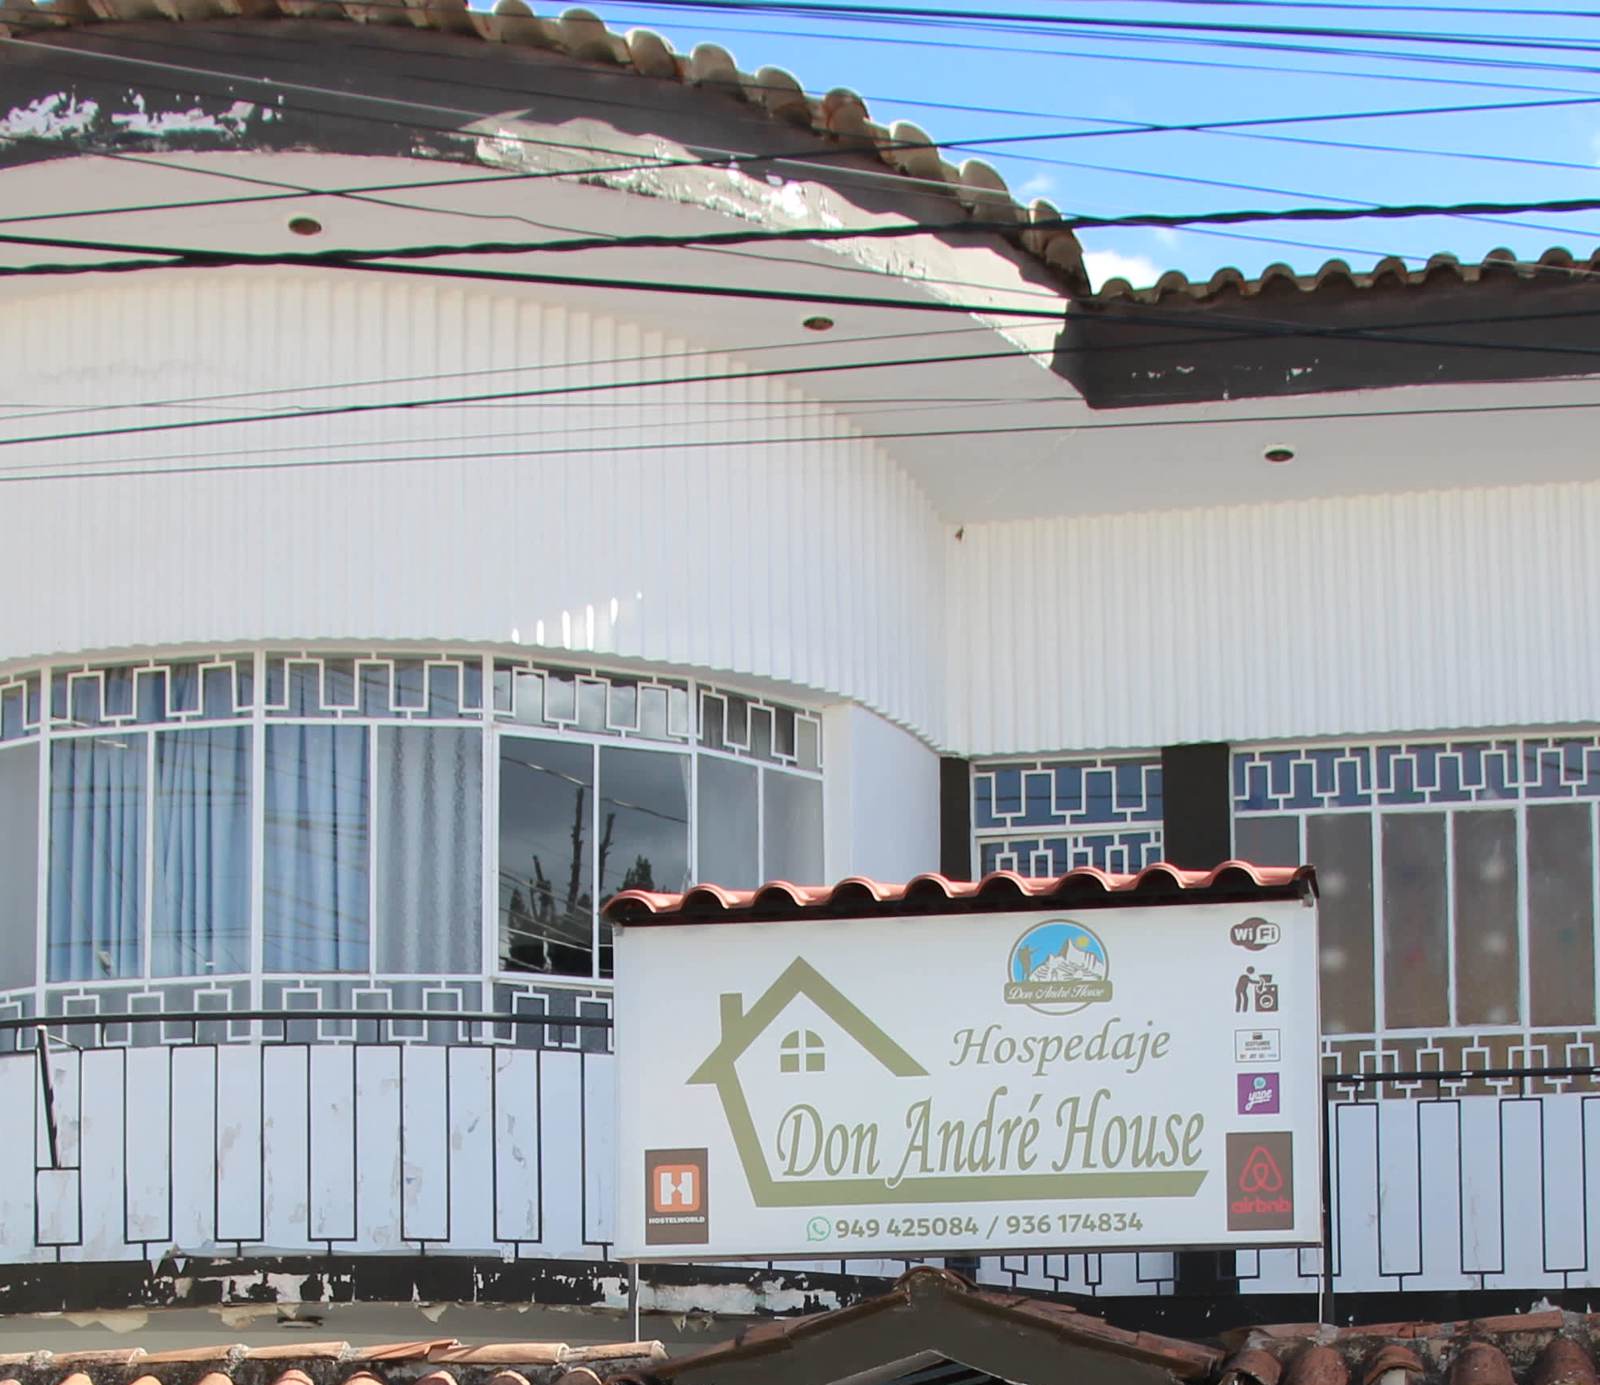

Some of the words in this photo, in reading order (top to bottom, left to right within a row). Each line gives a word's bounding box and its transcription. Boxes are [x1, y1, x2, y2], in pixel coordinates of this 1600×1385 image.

[1007, 985, 1033, 1000] Don
[948, 1016, 1171, 1077] Hospedaje
[776, 1102, 880, 1177] Don
[886, 1085, 1043, 1187] André
[1051, 1087, 1205, 1172] House
[1231, 1195, 1292, 1214] airbnb
[648, 1216, 706, 1225] HOSTELWORLD
[835, 1218, 880, 1239] 949
[886, 1216, 979, 1238] 425084
[1006, 1214, 1051, 1235] 936
[1058, 1212, 1144, 1234] 174834
